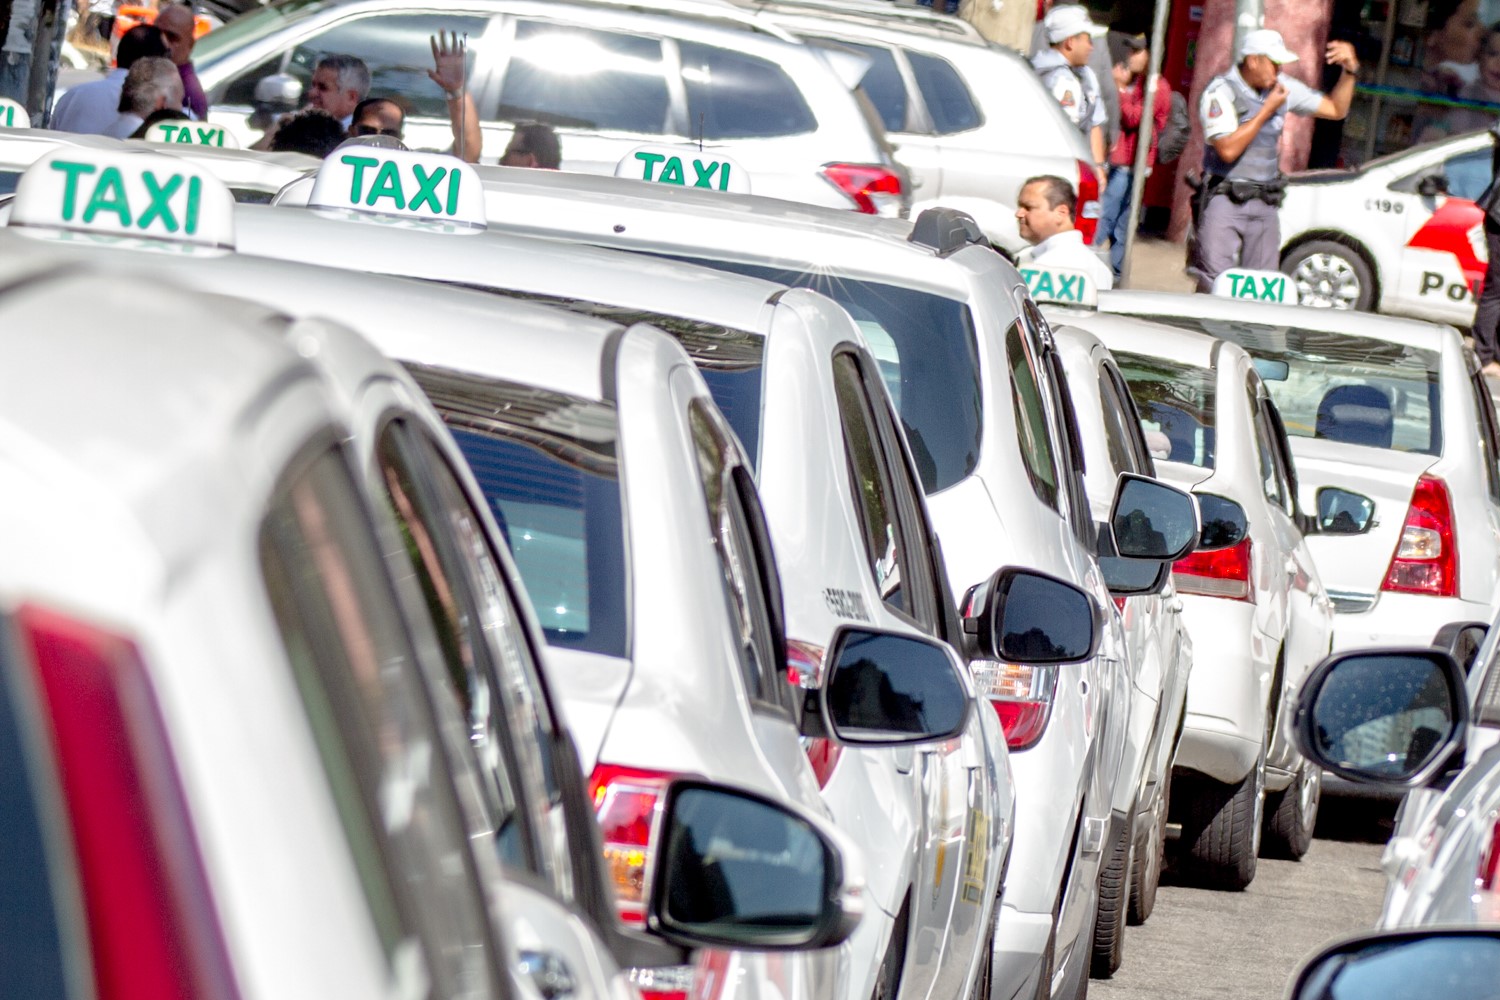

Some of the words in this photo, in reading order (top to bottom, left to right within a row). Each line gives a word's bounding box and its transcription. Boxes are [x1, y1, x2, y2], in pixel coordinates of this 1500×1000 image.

[159, 124, 225, 147] TAXI
[341, 156, 461, 216] TAXI
[634, 152, 731, 192] TAXI
[50, 160, 203, 235] TAXI
[1374, 198, 1405, 215] 190
[1020, 268, 1086, 303] TAXI
[1227, 273, 1286, 304] TAXI
